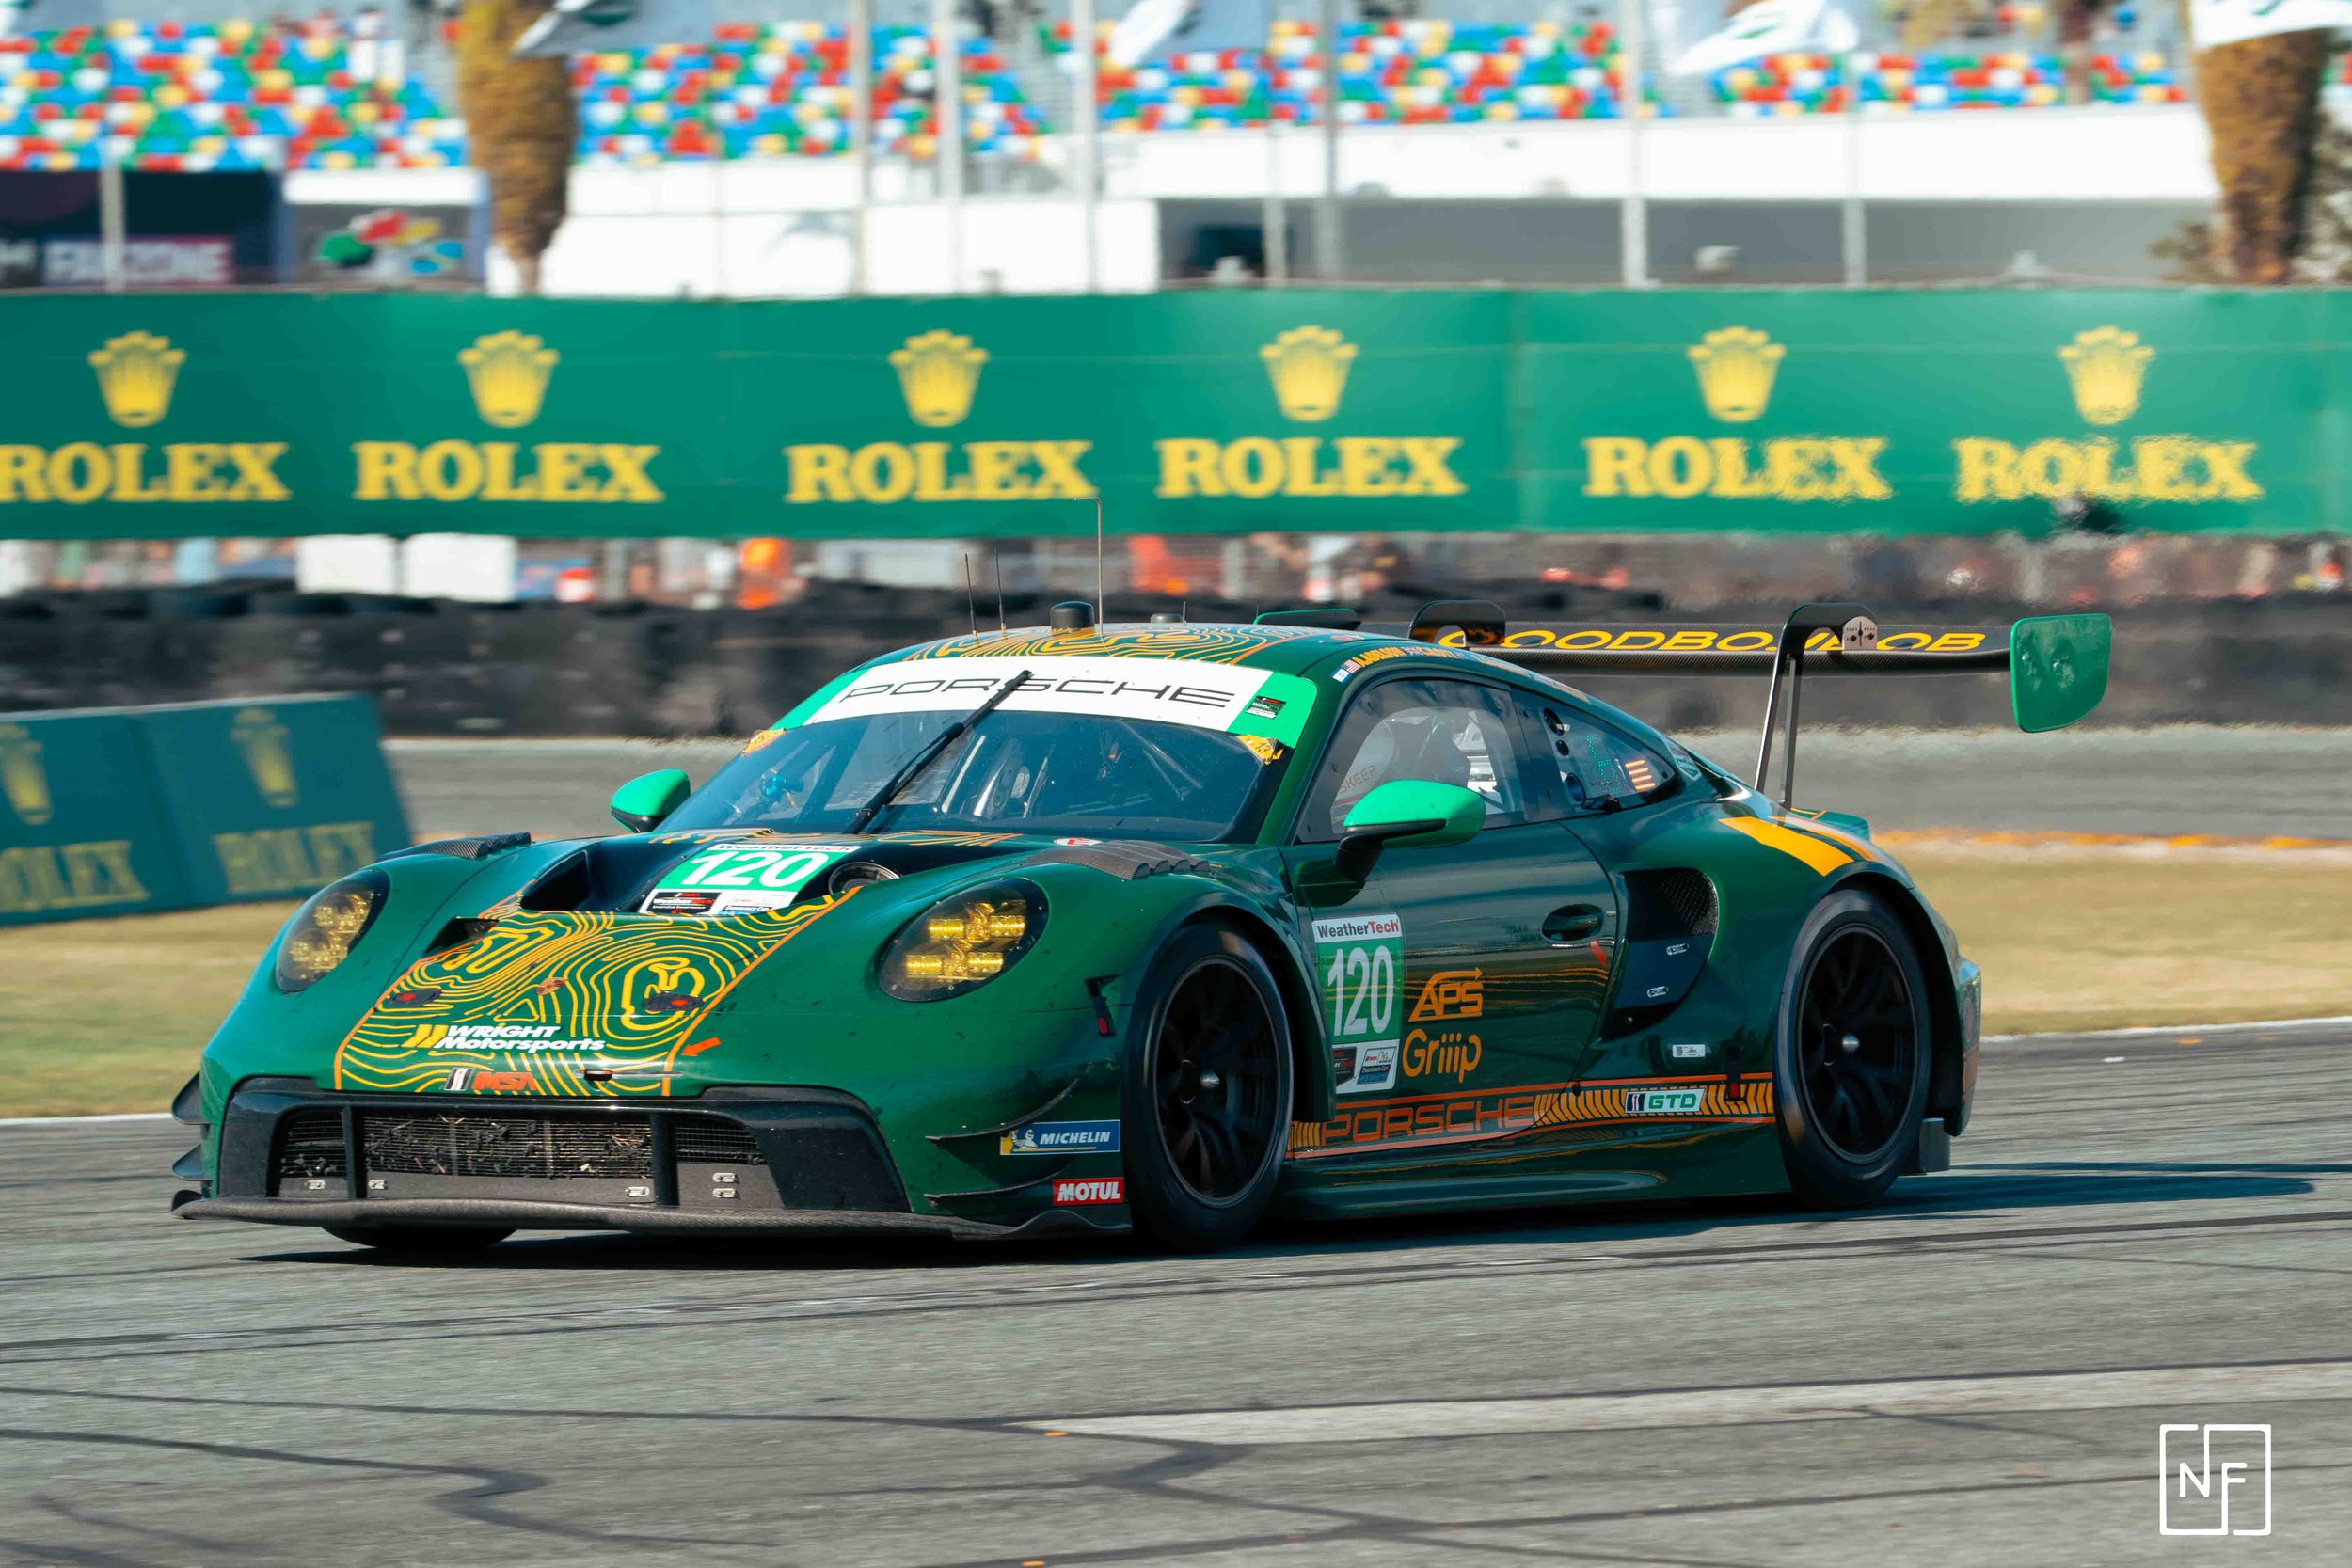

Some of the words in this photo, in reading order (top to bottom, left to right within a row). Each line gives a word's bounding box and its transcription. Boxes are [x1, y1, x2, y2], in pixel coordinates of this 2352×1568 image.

[0, 443, 290, 503] ROLEX
[355, 441, 663, 502] ROLEX
[787, 441, 1096, 503] ROLEX
[1158, 437, 1466, 498] ROLEX
[1585, 436, 1892, 500] ROLEX
[1954, 436, 2262, 501] ROLEX
[839, 676, 1235, 708] PORSCHE
[681, 850, 830, 888] 120
[1316, 919, 1400, 939] WeatherTech
[1327, 944, 1395, 1037] 120
[1409, 974, 1484, 1022] APS
[433, 1036, 606, 1053] Motorsports
[1320, 1096, 1534, 1145] PORSCHE
[1648, 1093, 1697, 1110] GTD
[1039, 1131, 1111, 1145] MICHELIN
[1057, 1181, 1120, 1201] MOTUL
